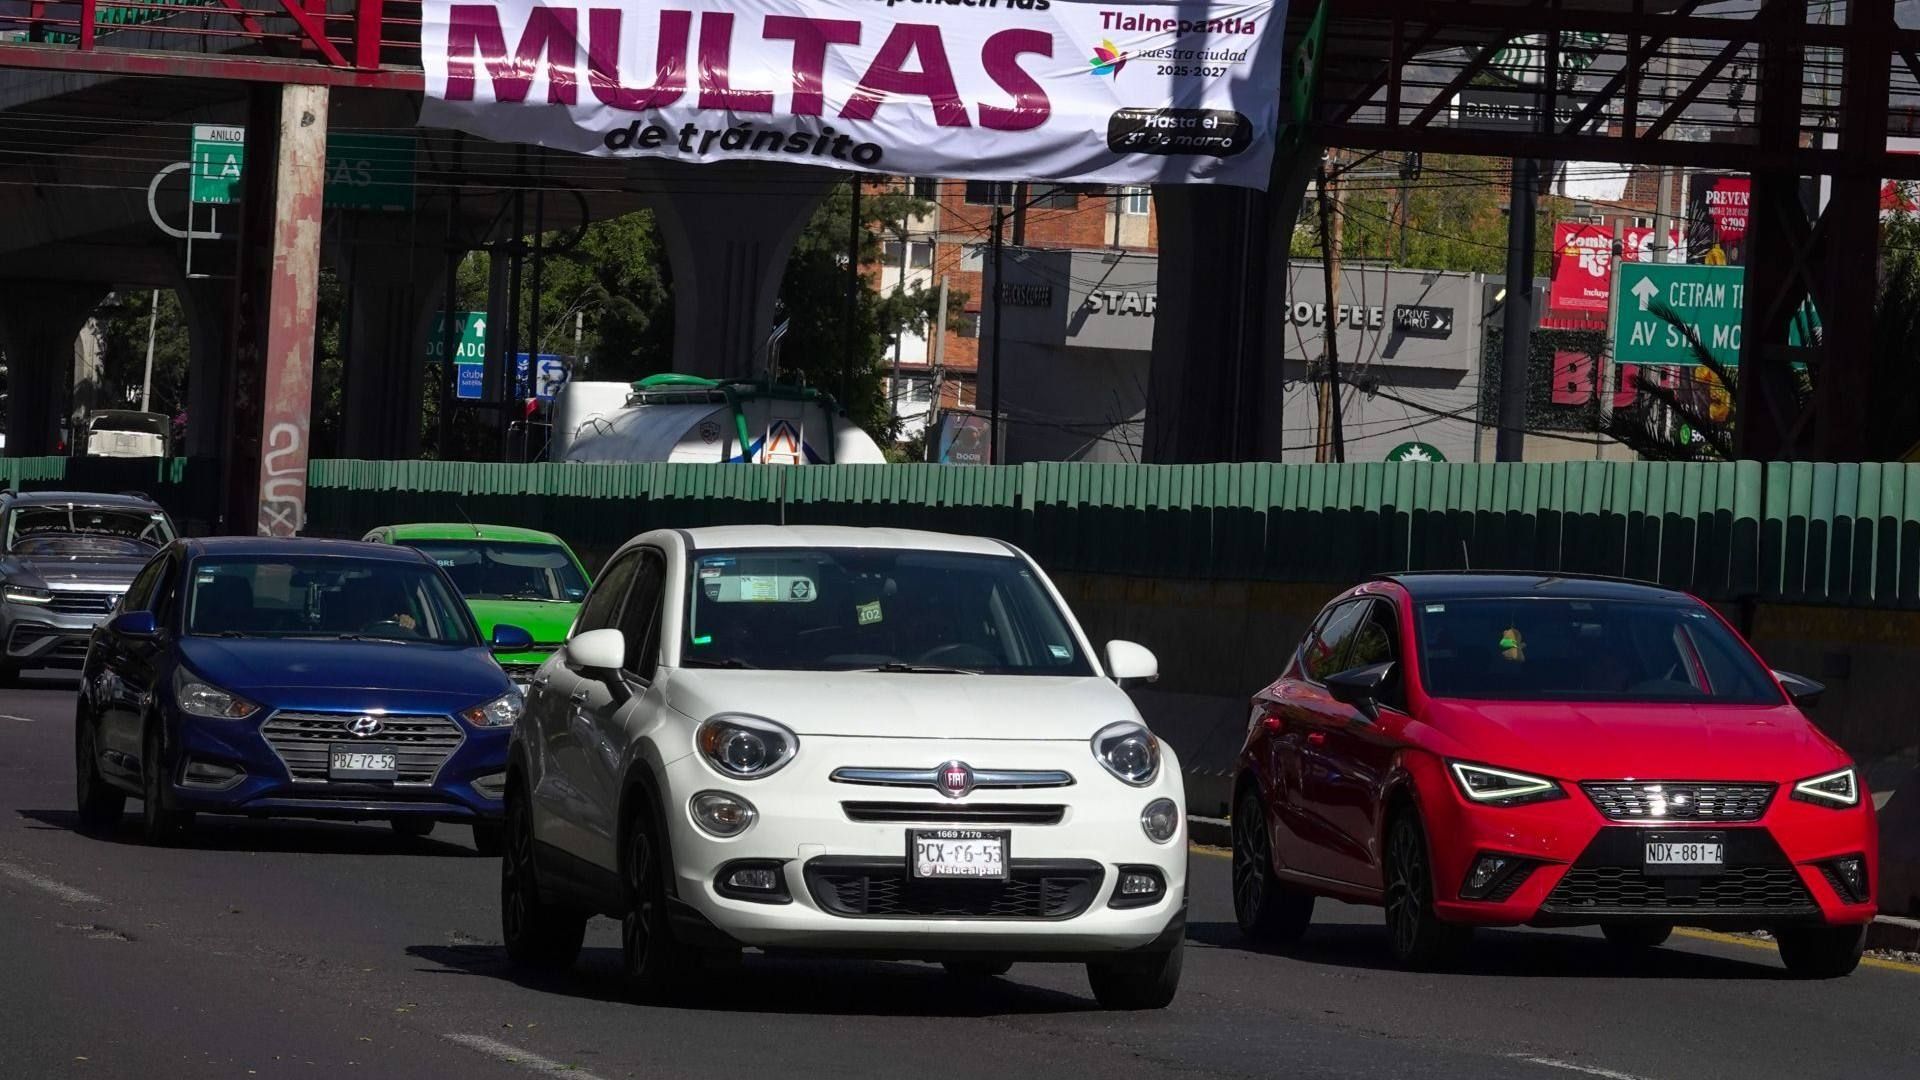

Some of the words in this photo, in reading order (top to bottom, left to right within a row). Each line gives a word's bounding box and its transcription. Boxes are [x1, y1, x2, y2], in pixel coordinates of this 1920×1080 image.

[1099, 11, 1256, 37] Tlalnepantla
[1196, 48, 1247, 62] ciudad
[445, 4, 1053, 132] MULTAS
[1145, 115, 1197, 129] Hasta
[1202, 116, 1218, 129] el
[210, 130, 241, 141] ANILLO
[604, 119, 668, 149] de
[678, 121, 884, 165] tránsito
[1175, 134, 1233, 148] marzo
[1669, 281, 1726, 308] CETRAM
[1397, 308, 1430, 320] DRIVE
[1399, 317, 1428, 329] THRU
[1630, 320, 1657, 346] AV
[860, 609, 881, 622] 102
[333, 753, 395, 769] PBZ-72-52
[947, 772, 965, 787] FIAT
[937, 830, 958, 839] 1669
[960, 831, 982, 839] 7170
[1648, 843, 1722, 862] NDX-881-A
[936, 864, 1002, 877] Naucalpan
